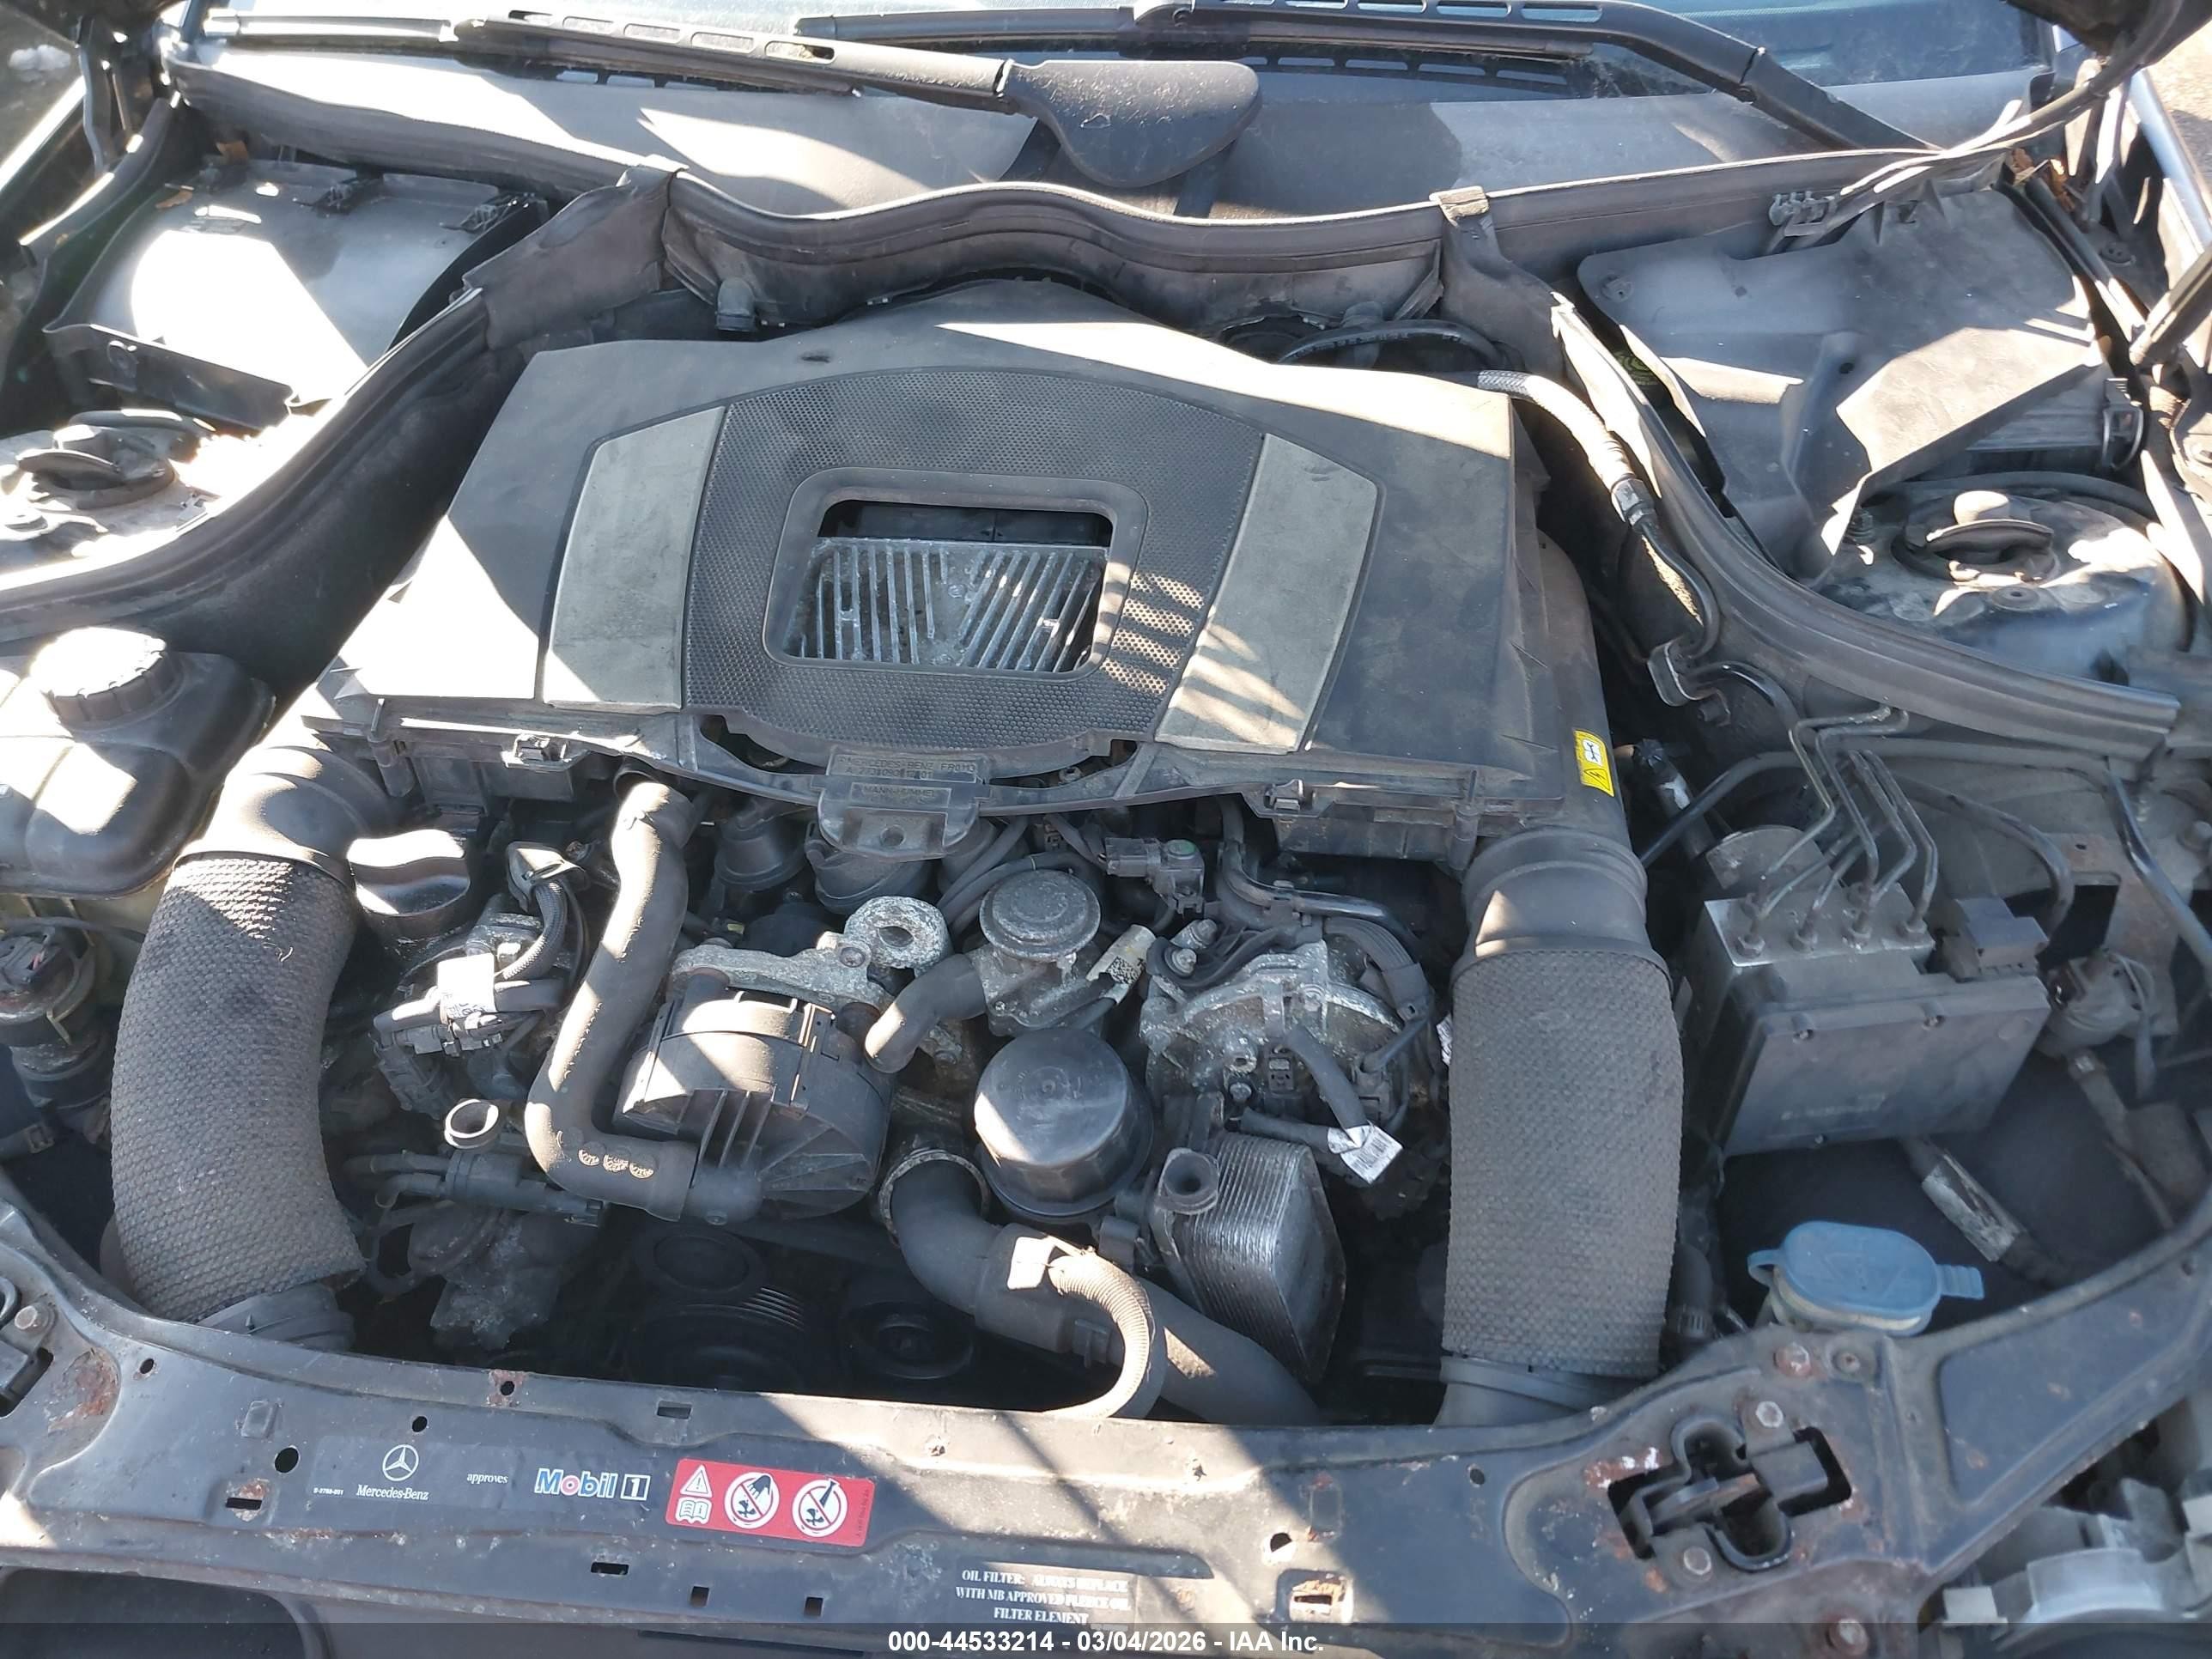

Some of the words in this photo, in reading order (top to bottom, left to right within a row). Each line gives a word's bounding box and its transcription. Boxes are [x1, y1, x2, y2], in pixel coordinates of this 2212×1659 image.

[466, 1473, 509, 1484] approves
[534, 1468, 618, 1498] Mobil
[356, 1485, 429, 1501] Mercedes-Benz
[962, 1570, 981, 1582] OIL
[983, 1571, 1025, 1585] FILTER:
[956, 1586, 986, 1600] WITH
[988, 1589, 1006, 1601] MB
[1006, 1589, 1065, 1606] APPROVED
[994, 1607, 1032, 1621] FILTER
[1035, 1610, 1090, 1625] ELEMENT
